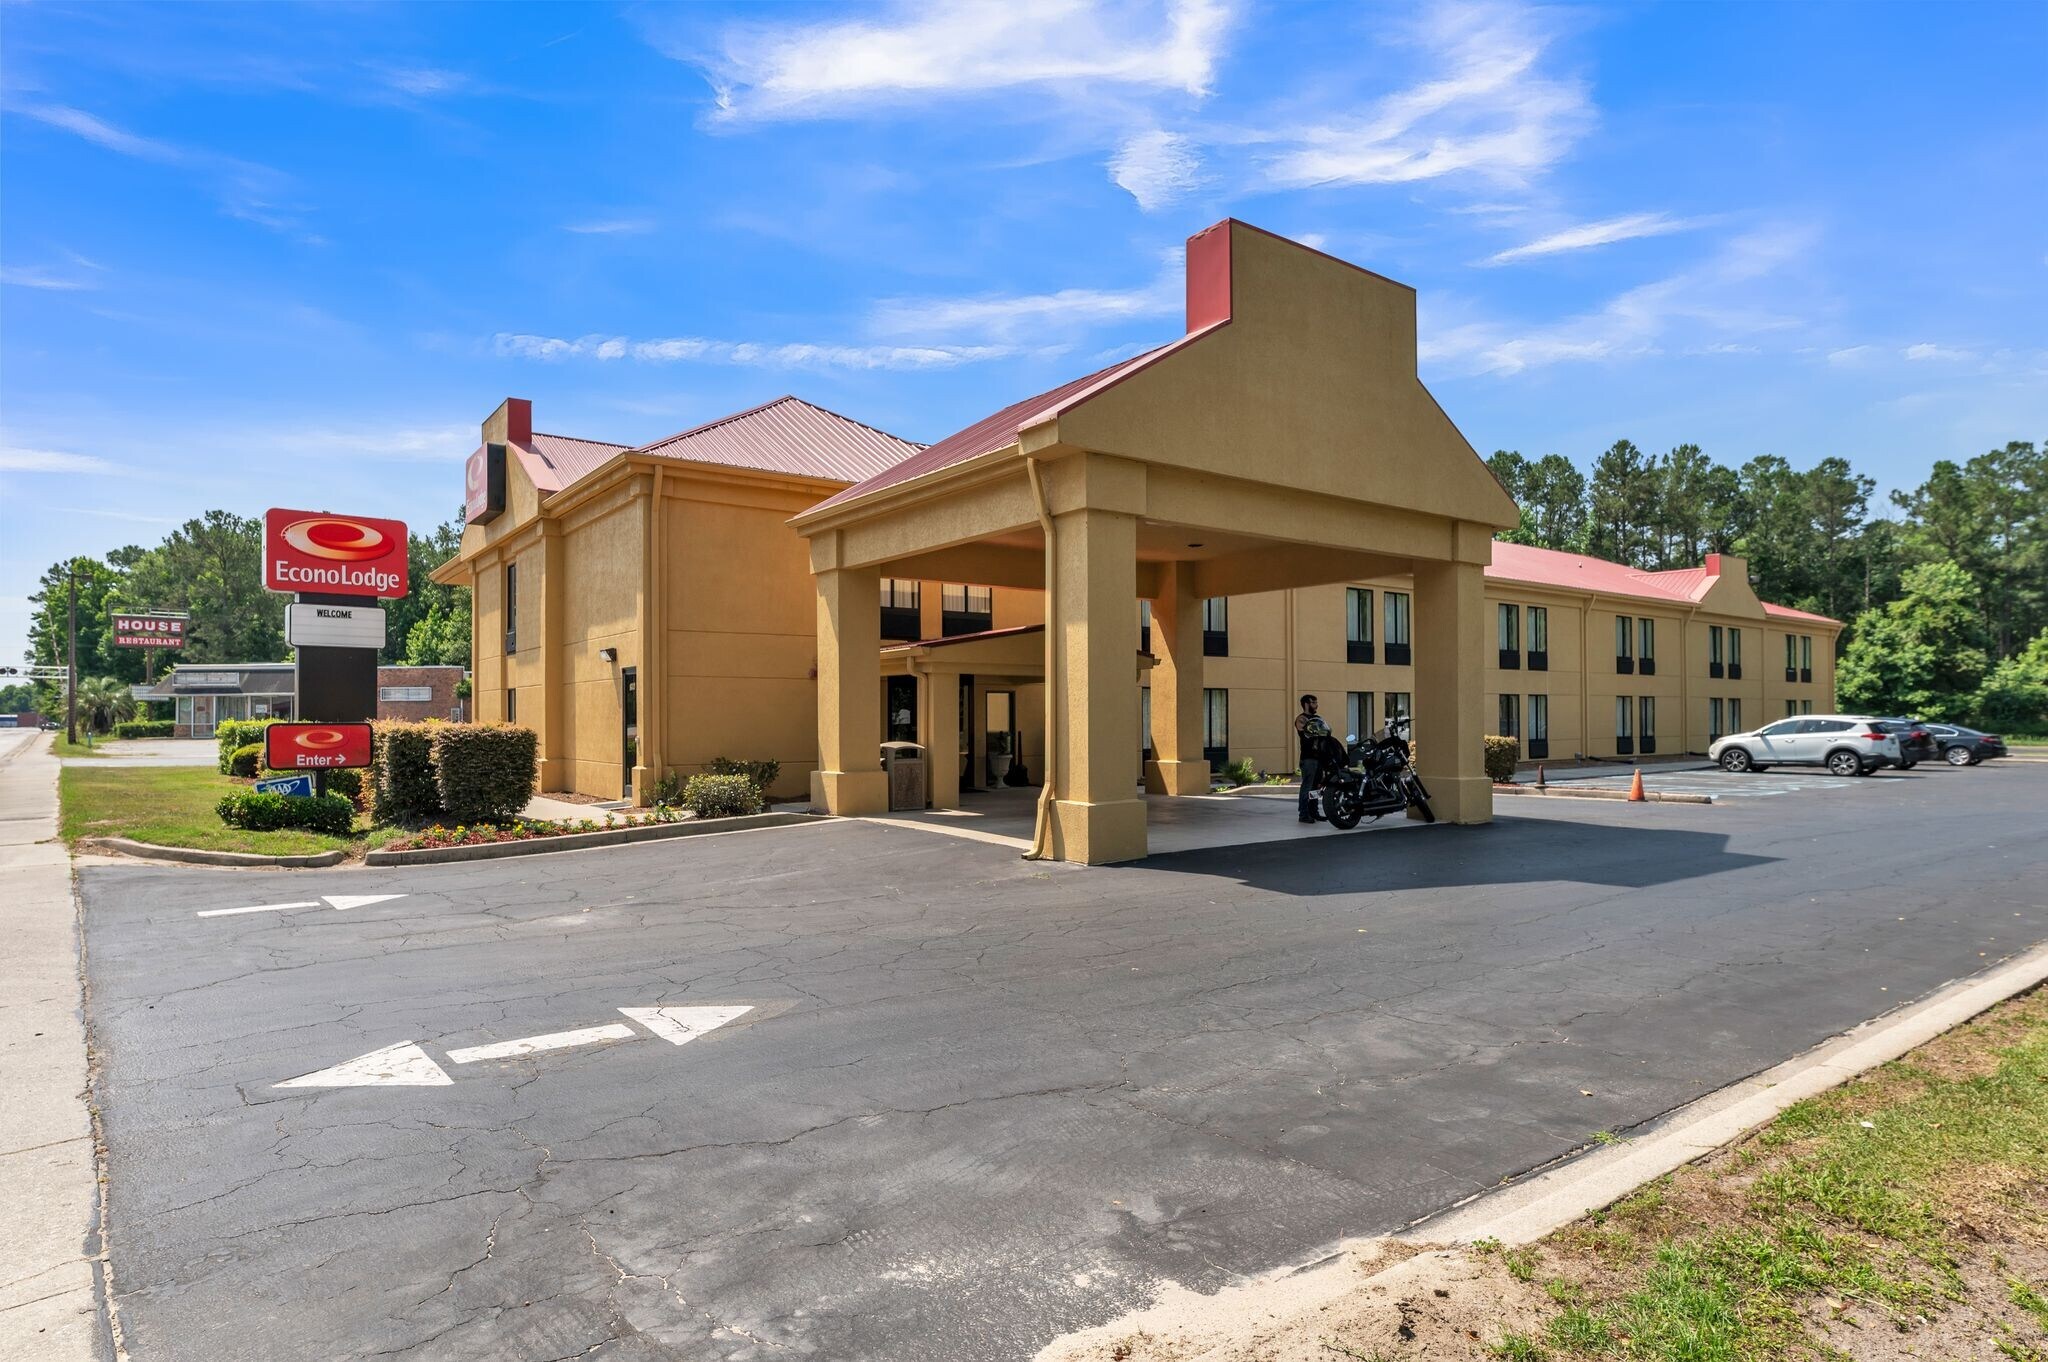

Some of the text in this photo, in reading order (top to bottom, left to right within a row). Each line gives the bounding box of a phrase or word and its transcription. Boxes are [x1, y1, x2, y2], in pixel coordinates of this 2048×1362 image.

[276, 560, 400, 592] EconoLodge
[316, 609, 352, 619] WELCOME
[118, 620, 181, 632] HOUSE
[119, 637, 181, 646] RESTAURANT
[296, 754, 332, 766] Enter
